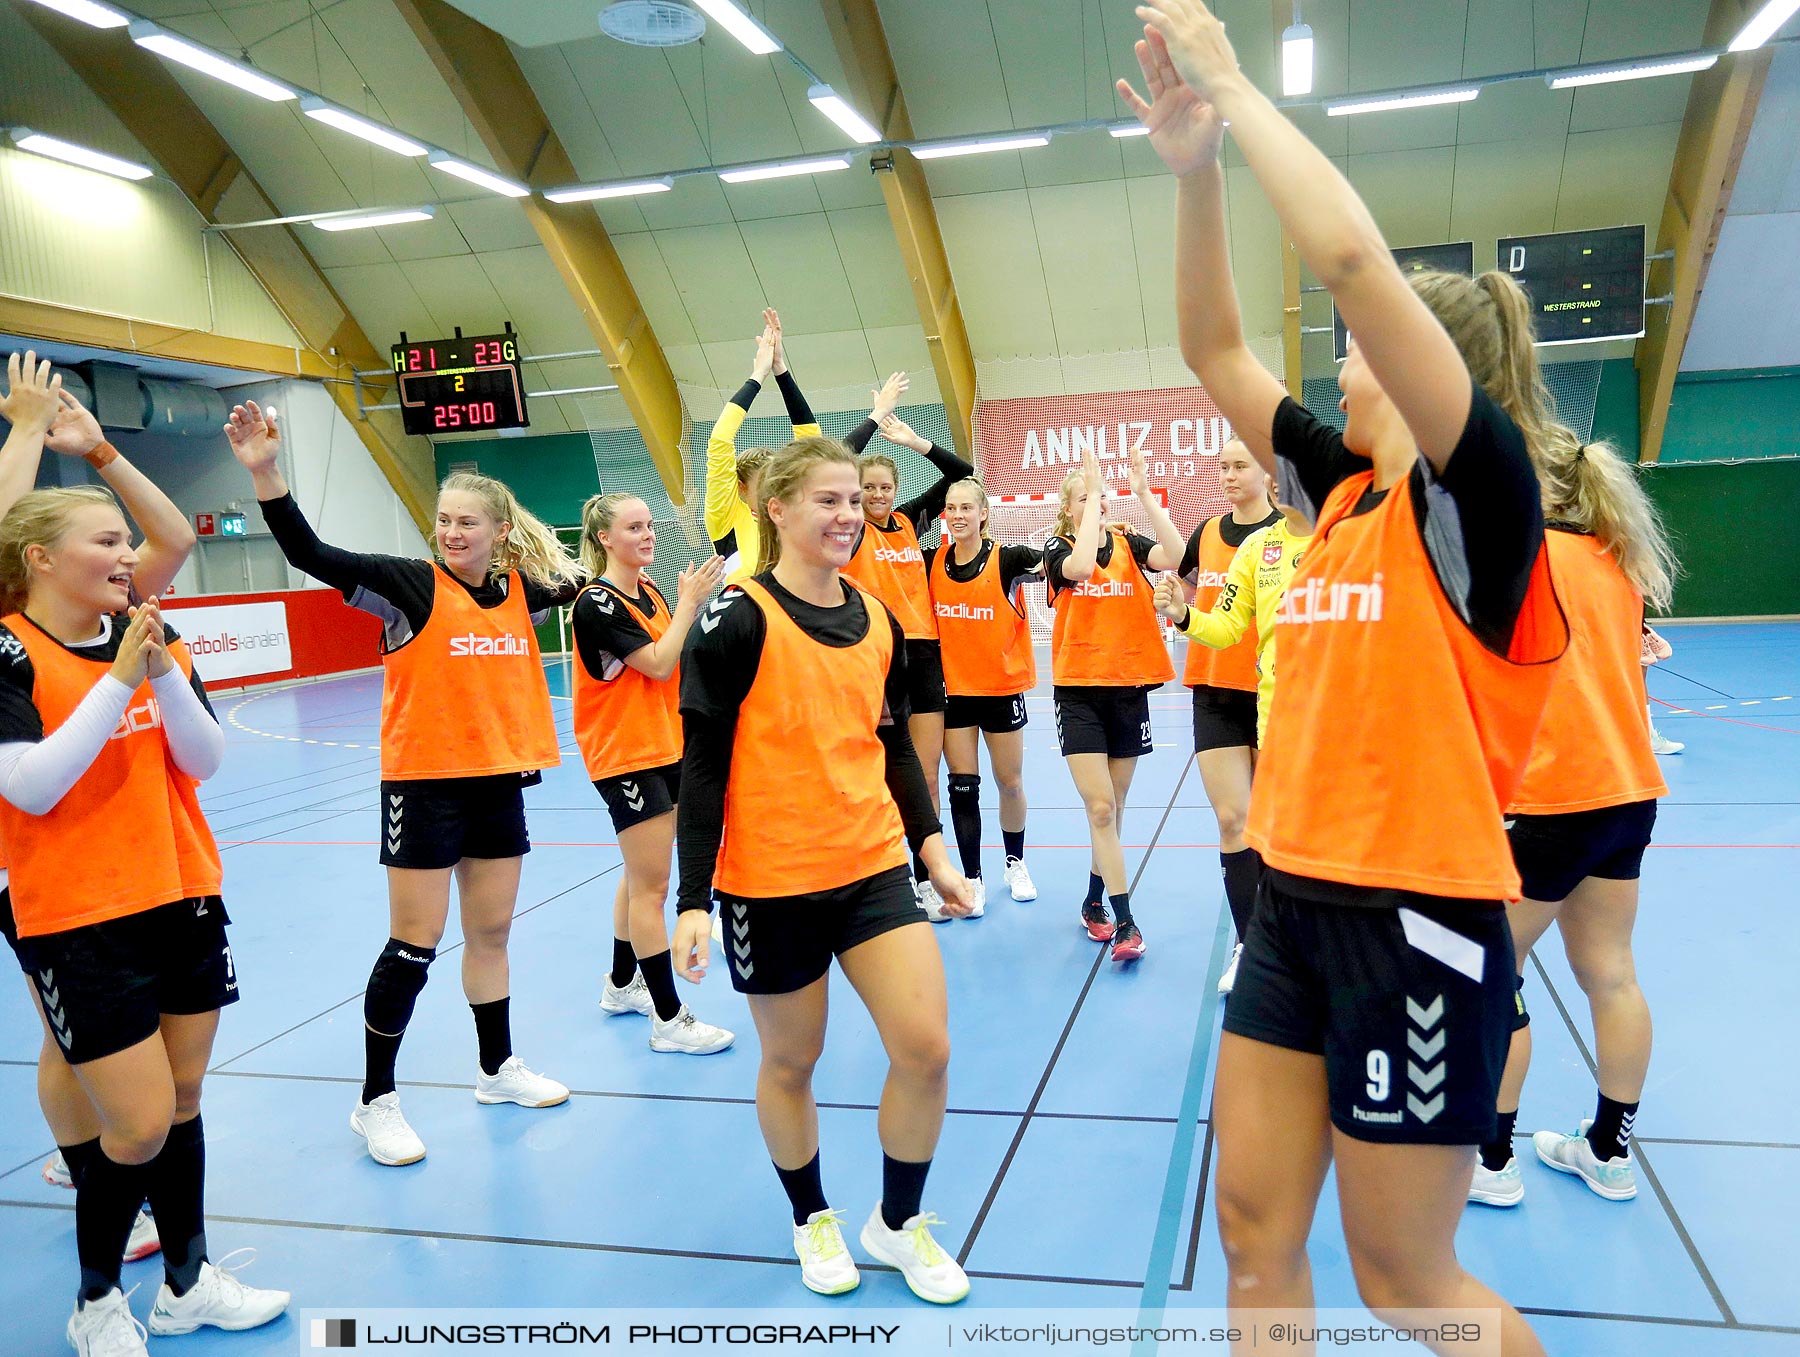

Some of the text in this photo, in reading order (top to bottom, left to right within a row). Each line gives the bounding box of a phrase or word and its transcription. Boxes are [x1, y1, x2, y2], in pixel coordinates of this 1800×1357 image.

[1510, 245, 1526, 273] D
[1543, 300, 1601, 312] WESTERSTRAND
[409, 349, 436, 371] 21
[474, 341, 502, 365] 23
[503, 340, 516, 361] G
[454, 375, 465, 392] 2
[1021, 421, 1154, 470] ANNLIZ
[874, 546, 924, 563] stadiu
[1275, 577, 1384, 624] adium
[184, 630, 286, 656] ndbollskanalen
[1012, 700, 1020, 717] 6
[1140, 720, 1151, 741] 23
[1366, 1049, 1390, 1102] 9
[1352, 1104, 1403, 1124] hummel
